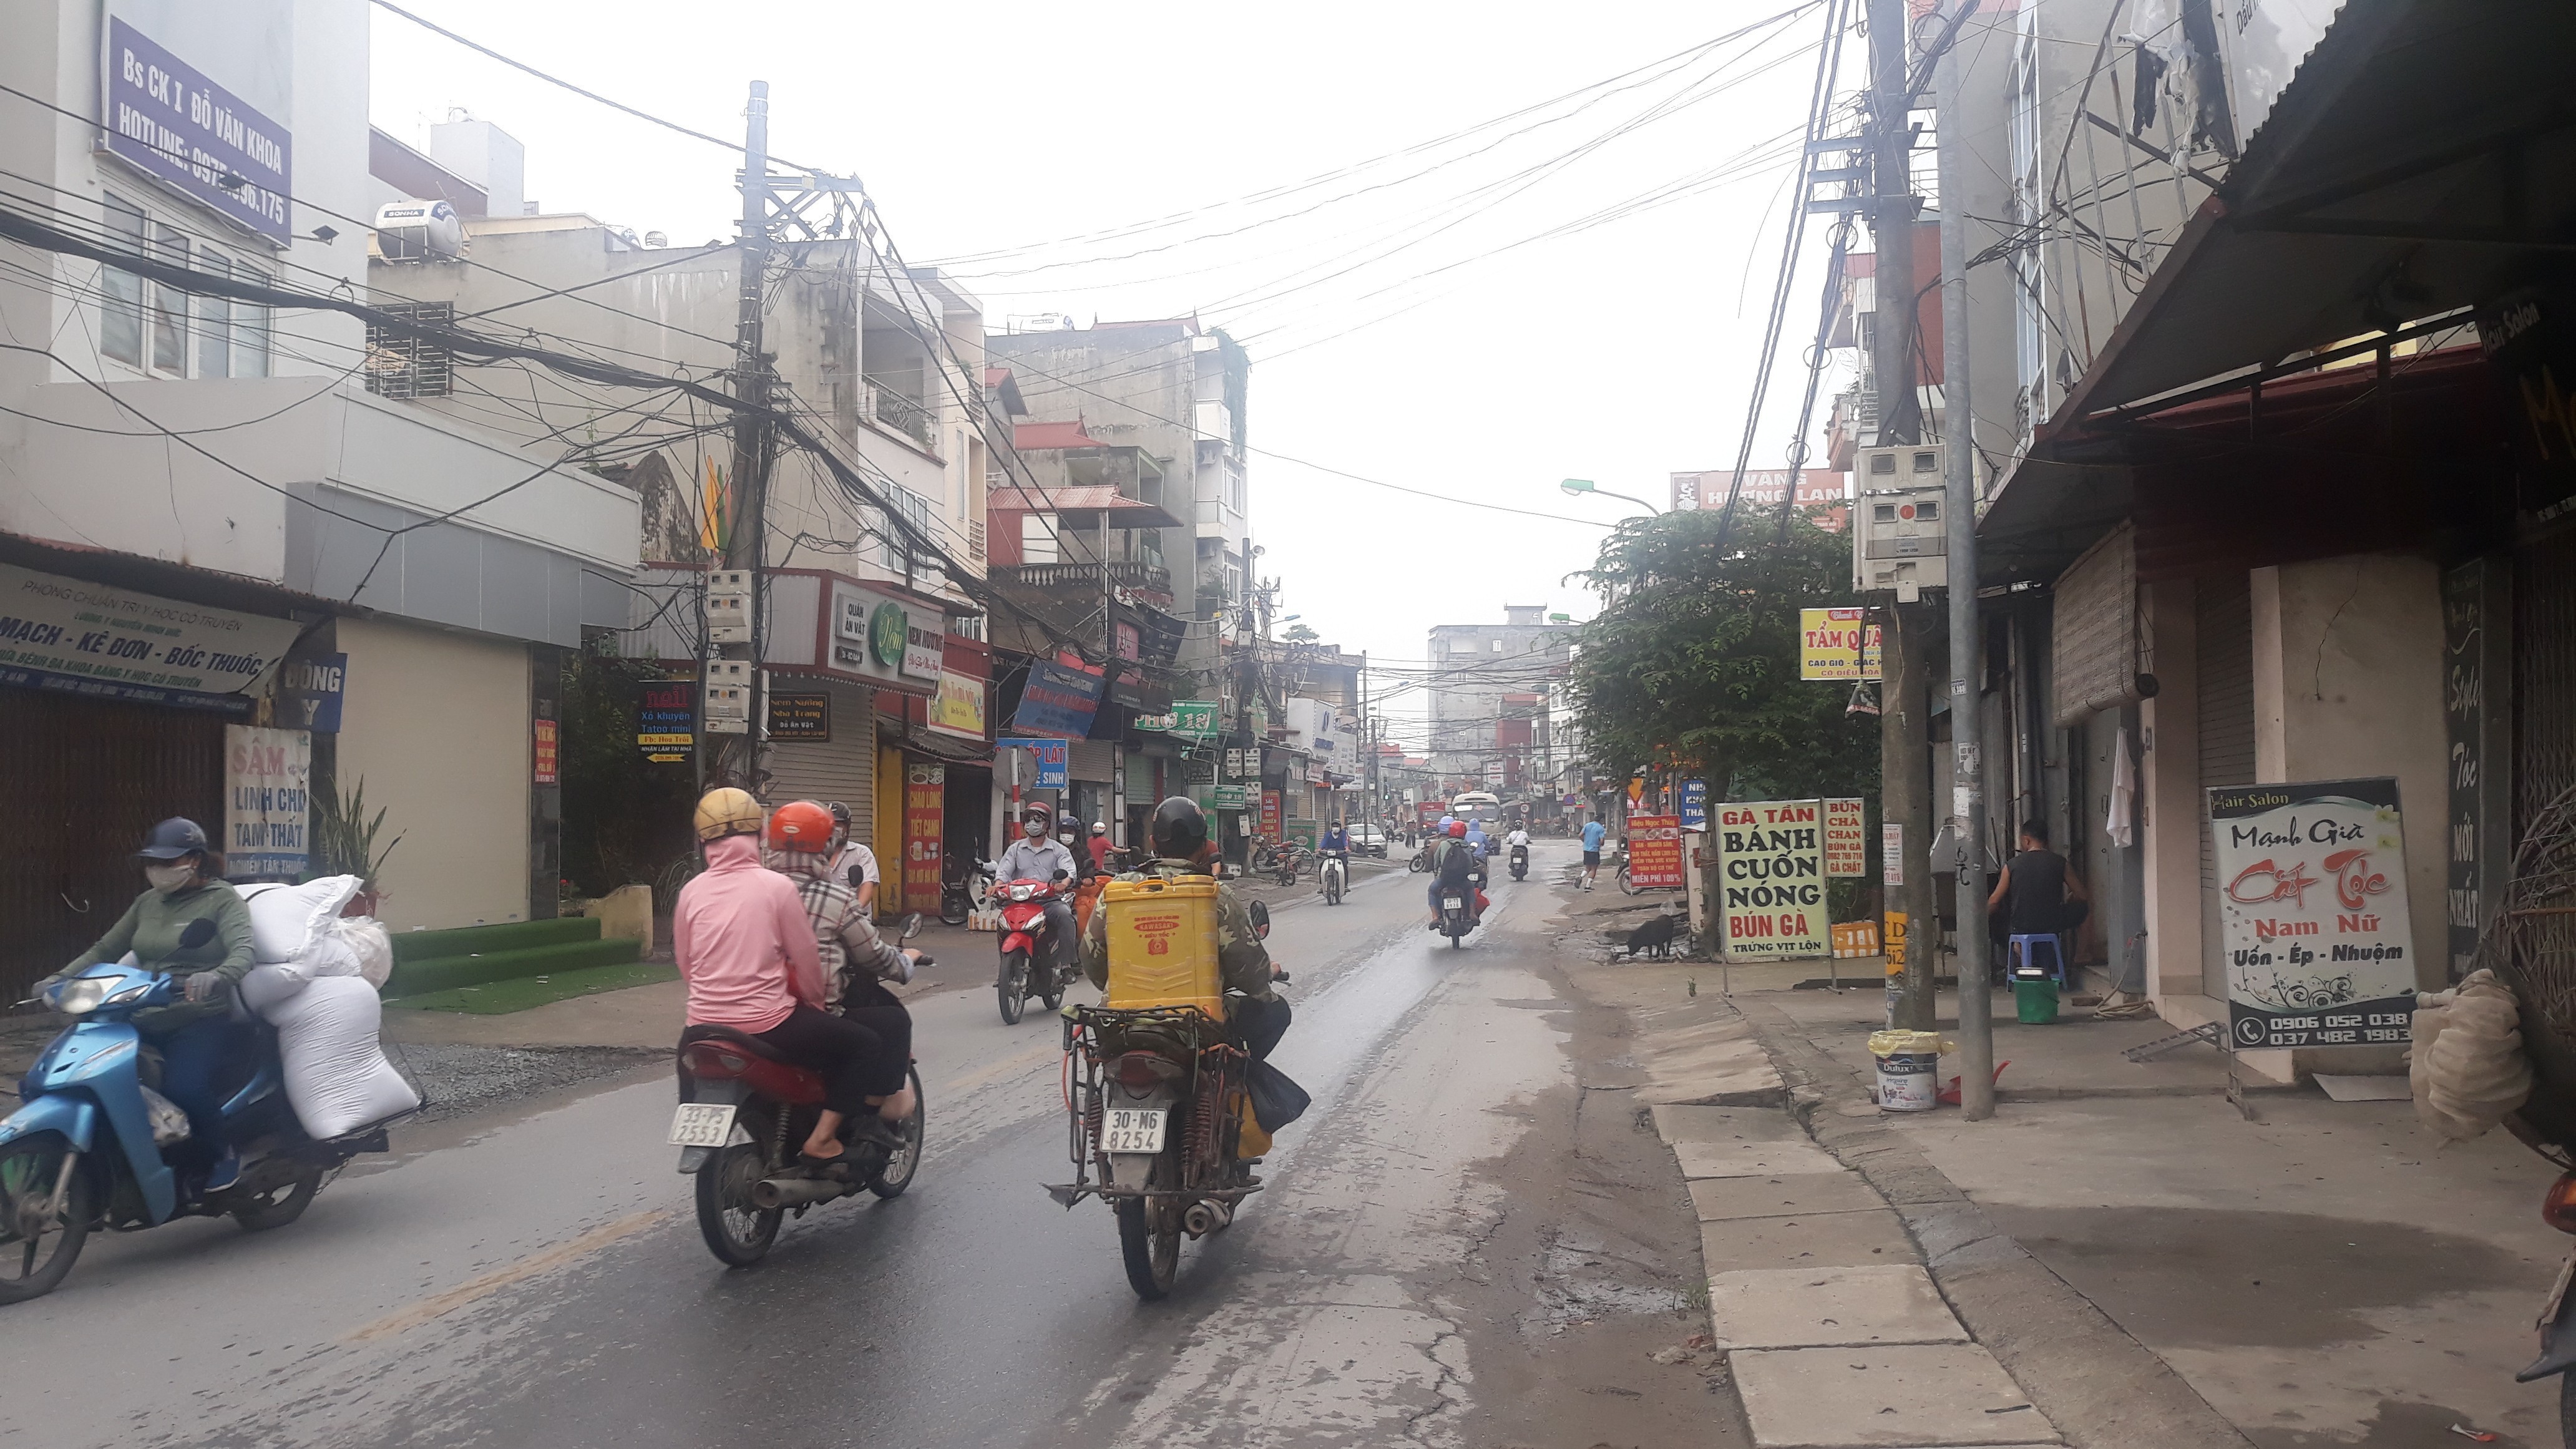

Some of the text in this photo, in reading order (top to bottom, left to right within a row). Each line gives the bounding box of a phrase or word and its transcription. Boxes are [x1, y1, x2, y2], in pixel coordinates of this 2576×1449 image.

[123, 47, 282, 175] Bs CK I ĐỖ VĂN KHOA
[119, 102, 189, 172] HOTLINE:
[2502, 301, 2540, 339] Salon
[1744, 472, 1807, 487] VÀNG
[1797, 488, 1842, 501] LAN
[848, 603, 864, 618] QUÁN
[1805, 620, 1843, 648] TẨM
[0, 616, 64, 646] MẠCH
[107, 637, 154, 660] ĐƠN
[164, 643, 207, 668] BỐC
[207, 651, 263, 676] THUỐC
[1853, 658, 1875, 666] GÁC
[646, 685, 689, 708] nail
[794, 698, 824, 708] Nướng
[301, 699, 321, 726] Y
[1184, 713, 1208, 729] 18
[642, 724, 691, 733] Tatoo mini
[232, 736, 285, 776] SÂM
[1045, 743, 1066, 764] LÁT
[1043, 772, 1064, 784] SINH
[235, 786, 273, 813] LINH
[2210, 792, 2289, 810] Hair Salon
[1722, 804, 1814, 826] GÀ TẦN
[1828, 814, 1860, 826] CHẢ
[234, 816, 303, 848] TAM THẤT
[1724, 824, 1817, 853] BÁNH
[1828, 830, 1860, 839] CHAN
[2231, 816, 2364, 849] Mạnh Già
[2454, 811, 2474, 863] MỚI
[1828, 841, 1861, 851] BÚN GÀ
[1727, 849, 1818, 881] CUỐN
[1830, 861, 1840, 873] GÀ
[1632, 872, 1681, 884] MIỄN PHÍ 100%
[2228, 849, 2391, 910] Cắt Tóc
[1726, 881, 1822, 909] NÓNG
[2449, 871, 2479, 928] NHẤT
[1730, 907, 1808, 939] BÚN GÀ
[2254, 914, 2381, 938] Nam Nữ
[1732, 939, 1822, 954] TRỨNG VỊT LỘN
[2233, 942, 2403, 967] Uốn Ép Nhuộm
[2270, 1013, 2408, 1030] 0906 052 038
[2270, 1028, 2413, 1046] 037 482 1983
[1883, 1064, 1910, 1072] Dulux
[1112, 1111, 1158, 1129] 30-M6
[669, 1125, 719, 1143] 2553
[1110, 1131, 1154, 1149] 8254
